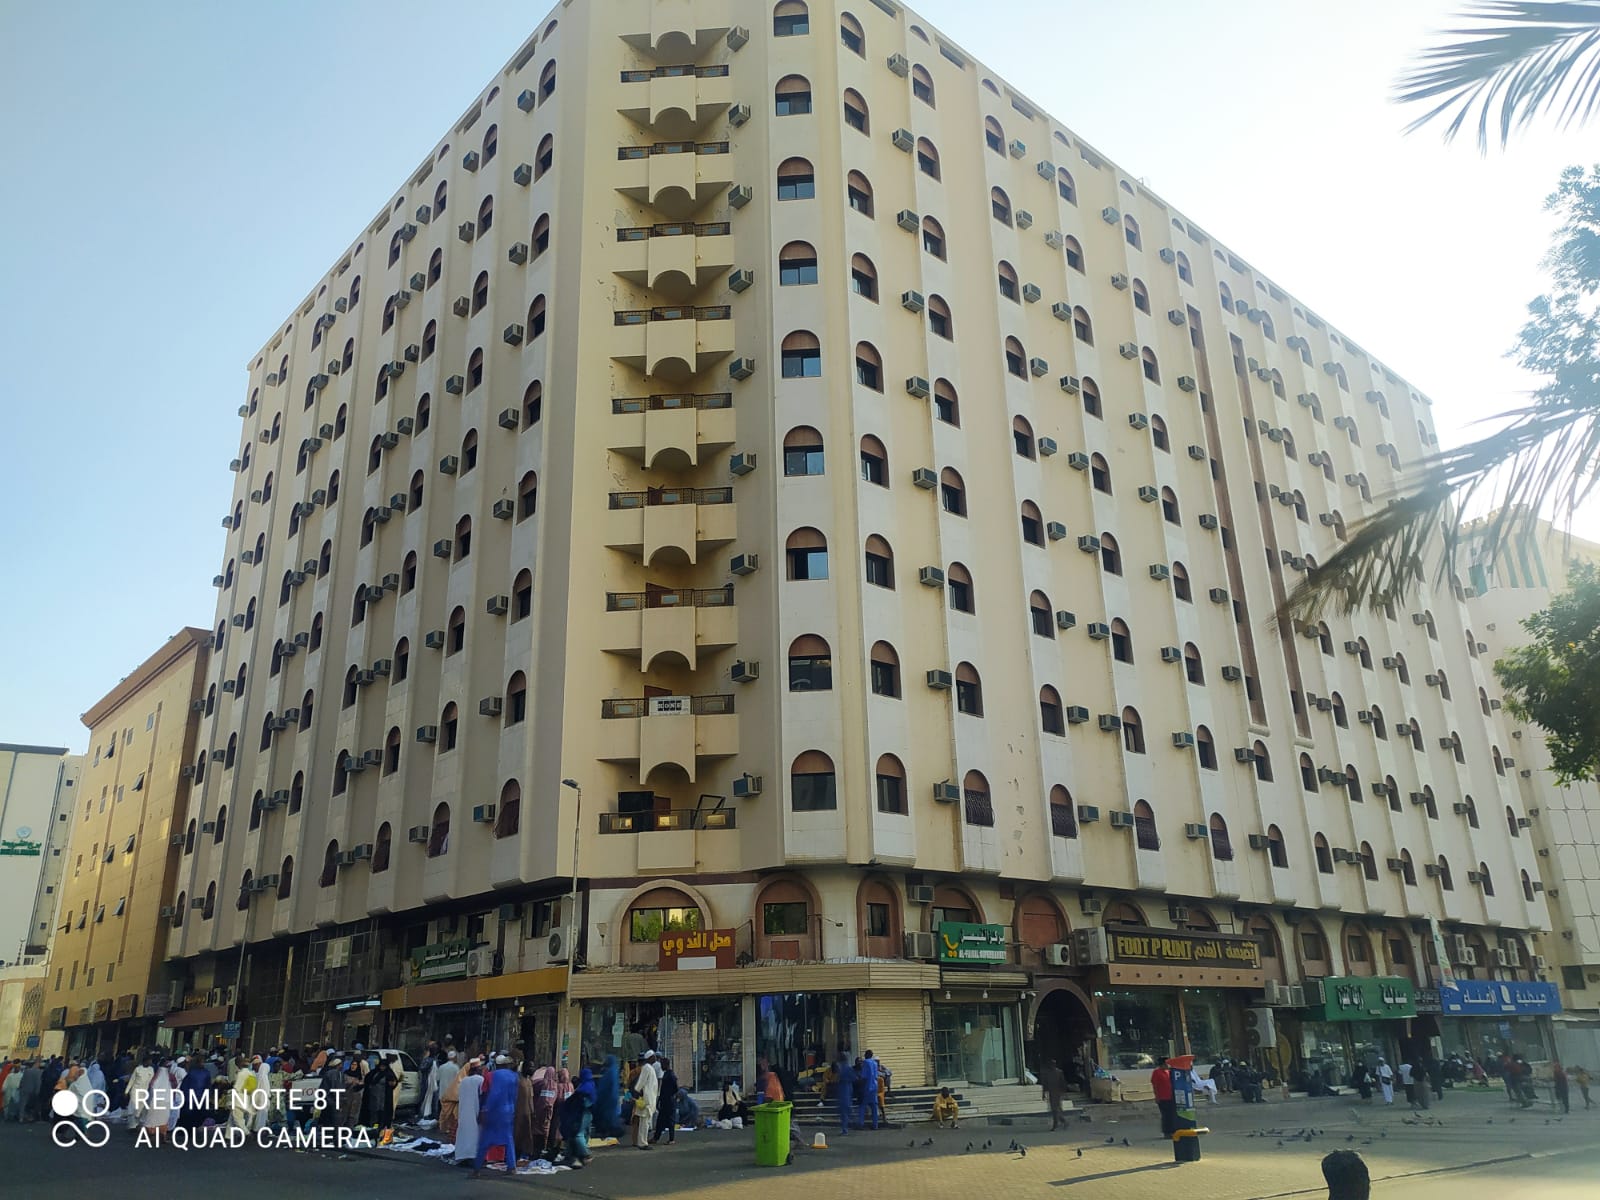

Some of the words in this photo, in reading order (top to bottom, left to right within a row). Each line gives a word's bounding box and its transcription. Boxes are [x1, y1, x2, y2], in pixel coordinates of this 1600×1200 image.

[709, 932, 731, 952] محل
[1117, 936, 1149, 957] FOOT
[1151, 938, 1193, 960] PRINT
[1174, 1071, 1182, 1081] P
